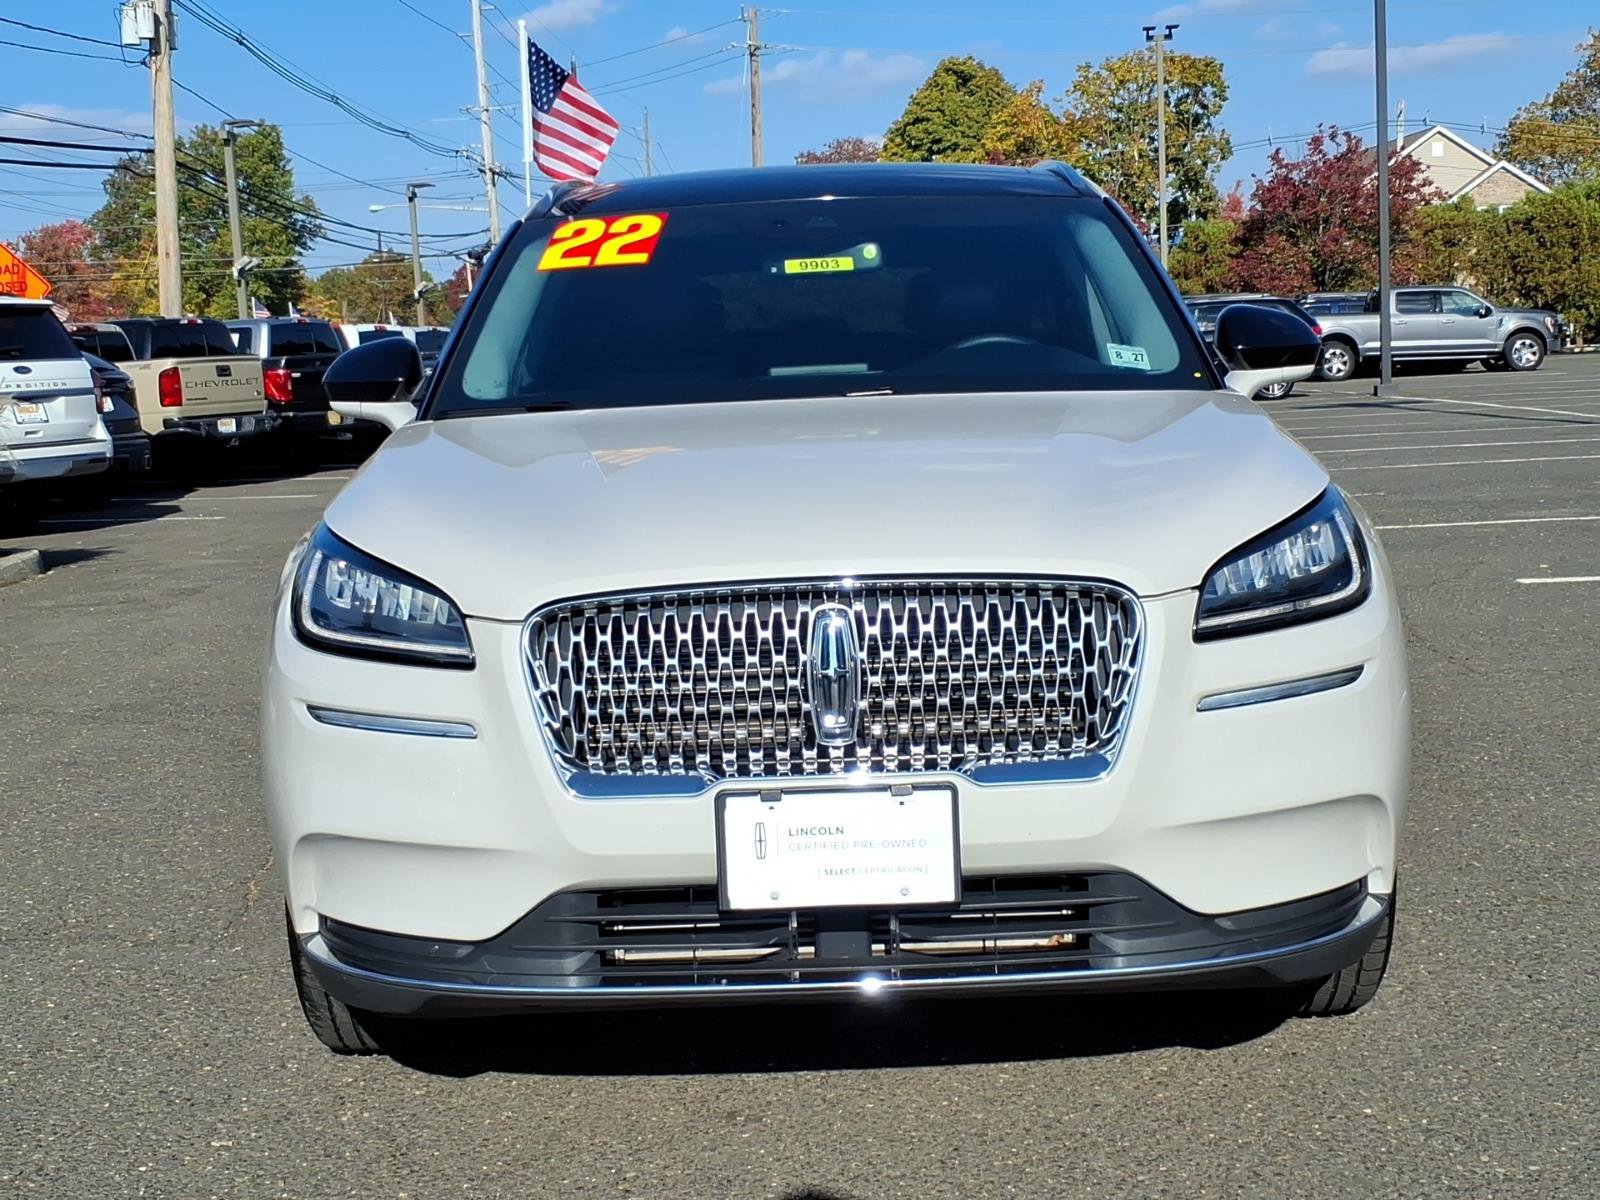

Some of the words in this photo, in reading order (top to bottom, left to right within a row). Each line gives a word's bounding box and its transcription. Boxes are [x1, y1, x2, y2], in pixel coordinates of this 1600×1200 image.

[537, 214, 662, 270] 22
[0, 264, 20, 275] AD
[799, 260, 840, 271] 9903
[1115, 350, 1123, 360] 8
[1132, 352, 1144, 362] 27
[185, 377, 259, 389] CHEVROLET
[788, 826, 845, 837] LINCOLN
[788, 840, 850, 852] CERTIFIED
[853, 838, 927, 849] PRE-OWNED
